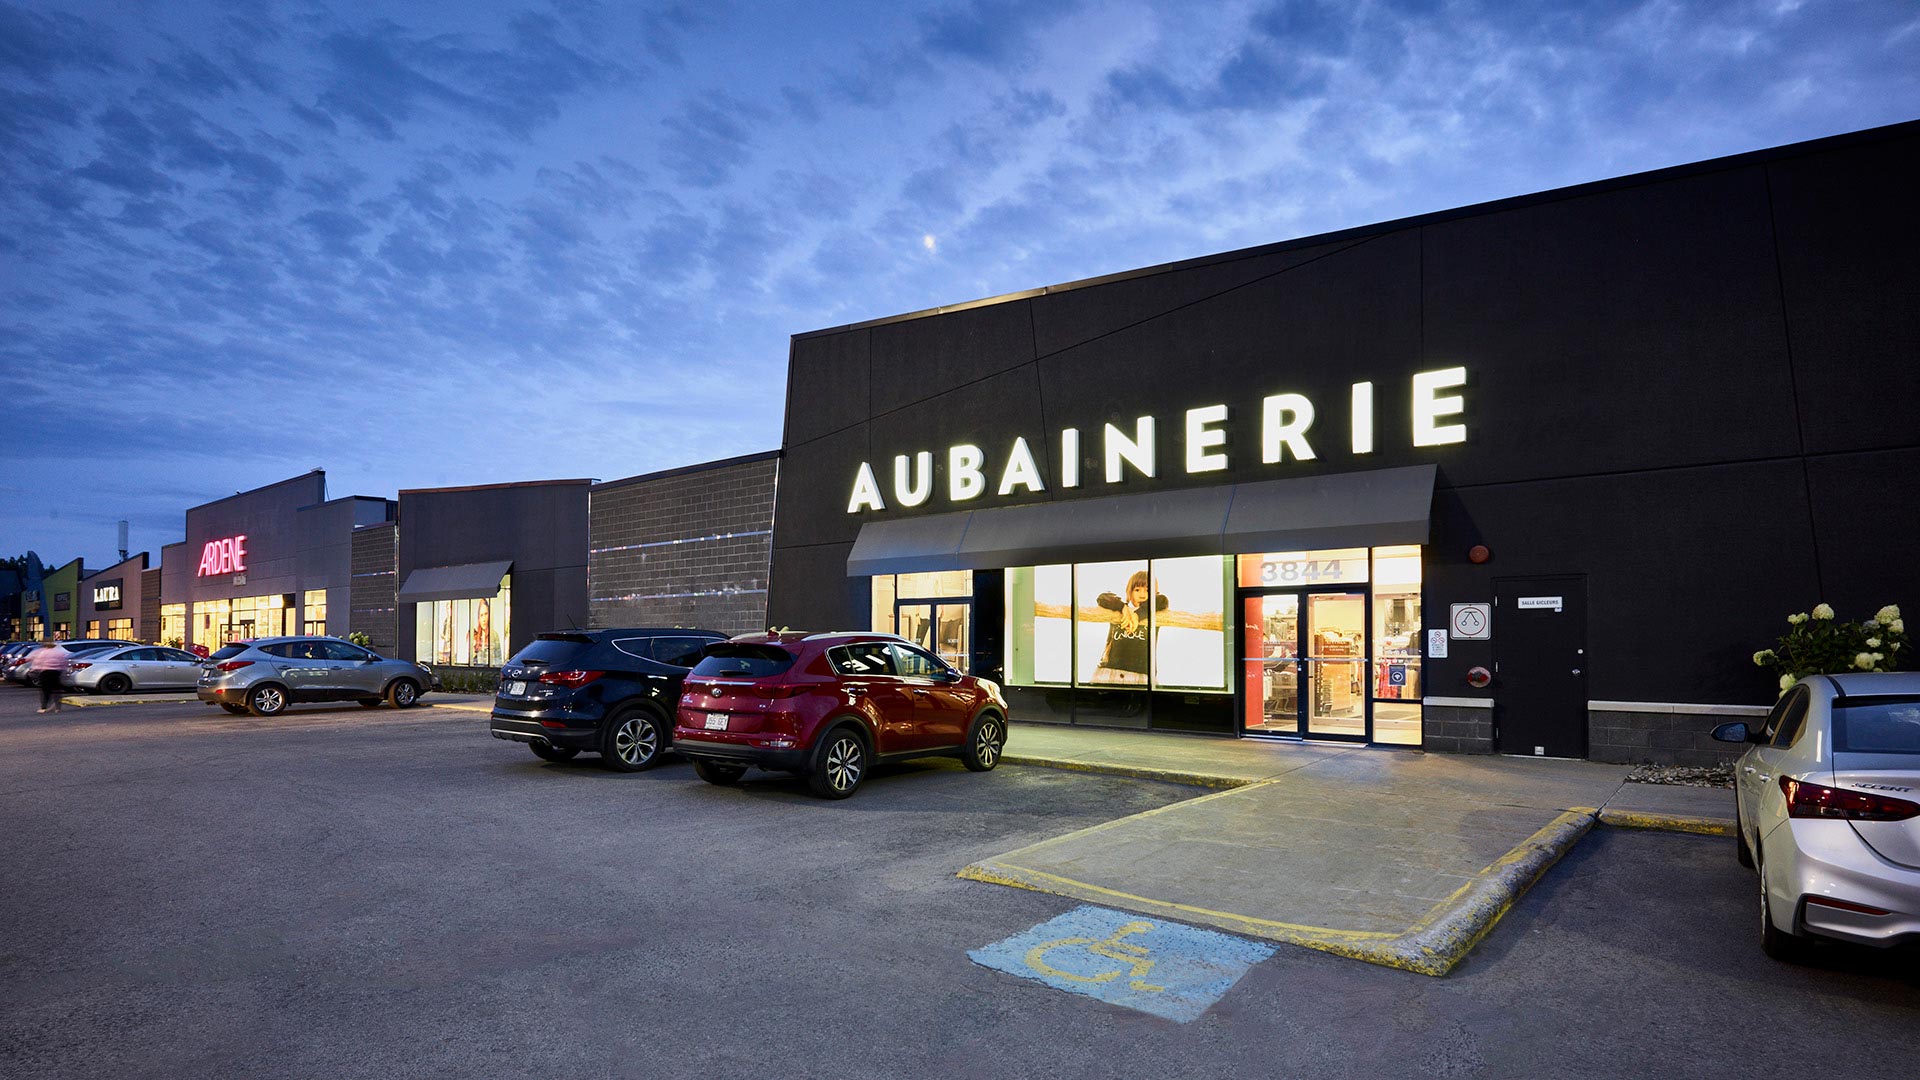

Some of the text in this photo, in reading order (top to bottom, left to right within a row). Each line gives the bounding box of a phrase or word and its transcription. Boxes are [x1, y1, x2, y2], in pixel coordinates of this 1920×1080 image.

[847, 366, 1468, 514] AUBAINERIE
[197, 535, 248, 577] ARDENE
[1260, 559, 1343, 582] 3844
[93, 586, 120, 603] LAURA
[1850, 782, 1914, 793] ACCENT
